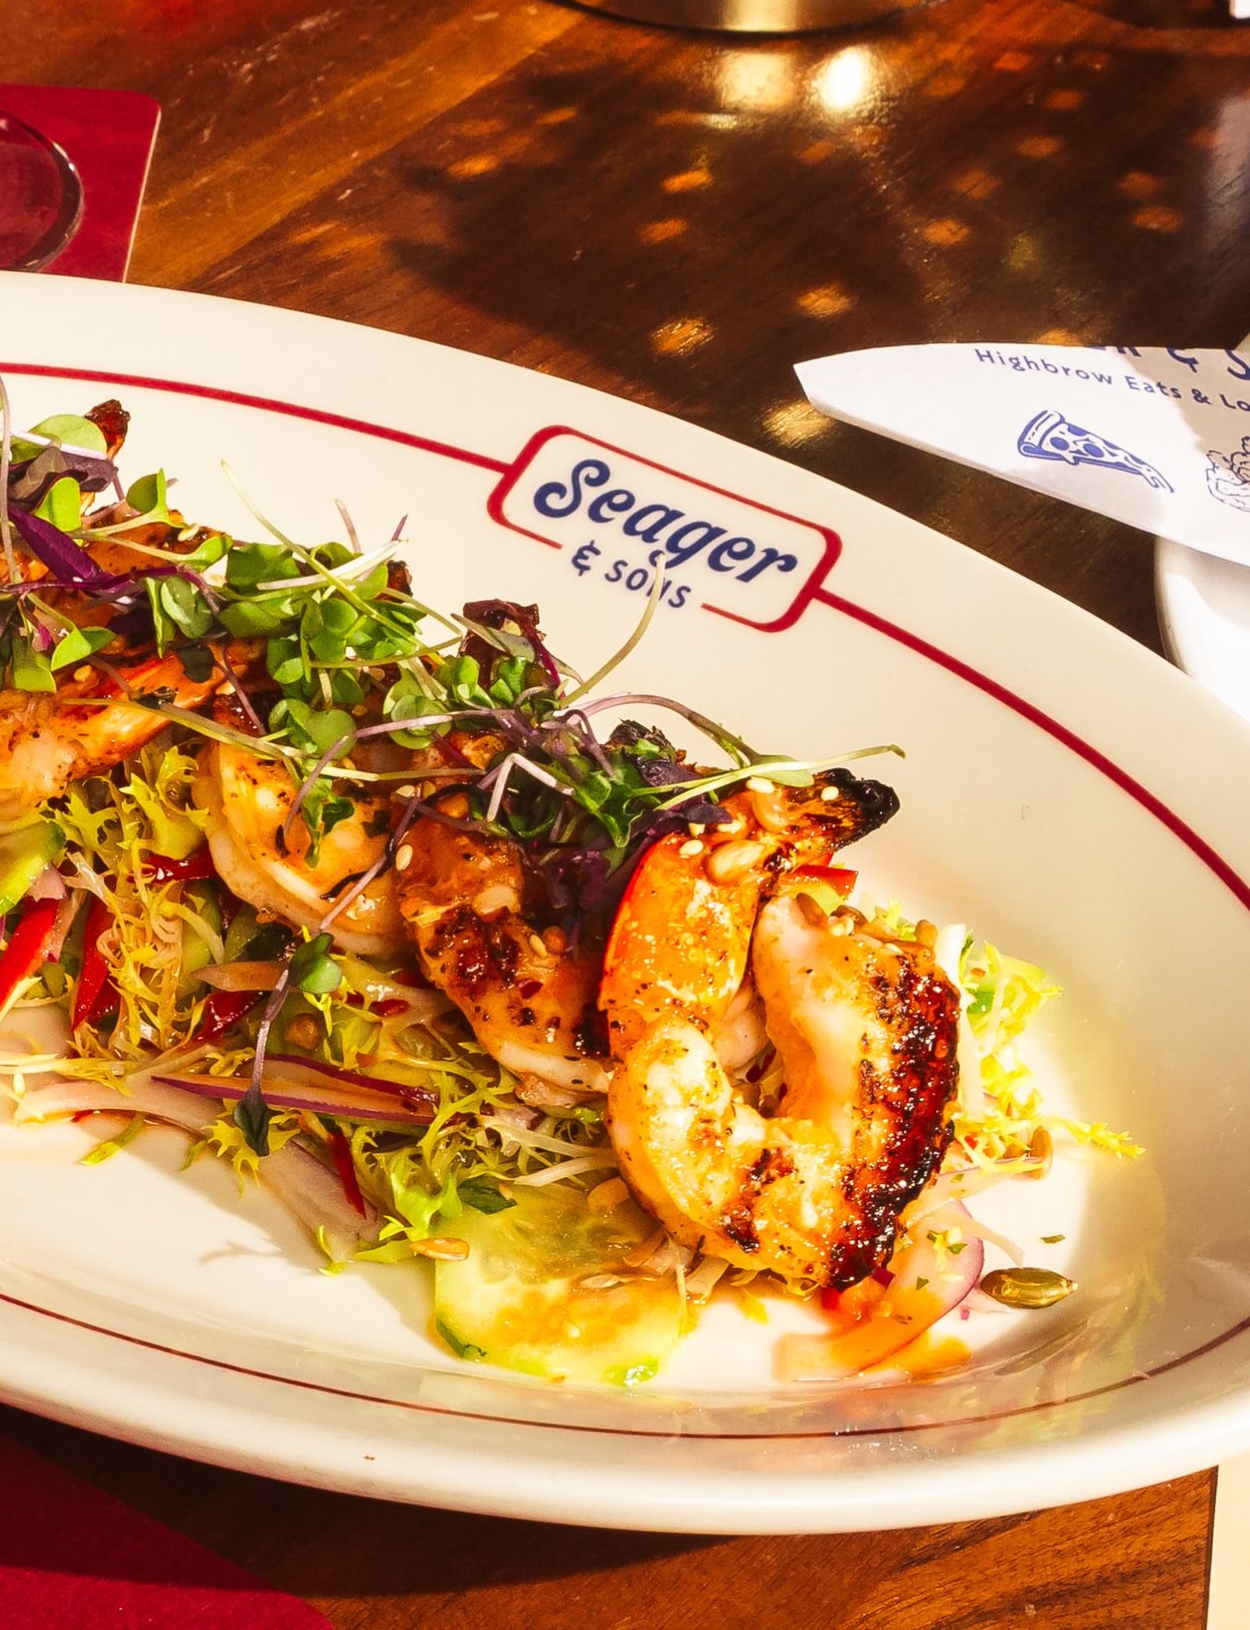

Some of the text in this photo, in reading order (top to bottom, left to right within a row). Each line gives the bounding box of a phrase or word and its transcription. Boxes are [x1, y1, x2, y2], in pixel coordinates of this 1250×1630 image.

[974, 348, 1113, 385] Highbrow
[1125, 376, 1182, 399] Eats
[1191, 388, 1212, 405] &
[533, 458, 798, 583] Seager
[571, 539, 602, 577] &
